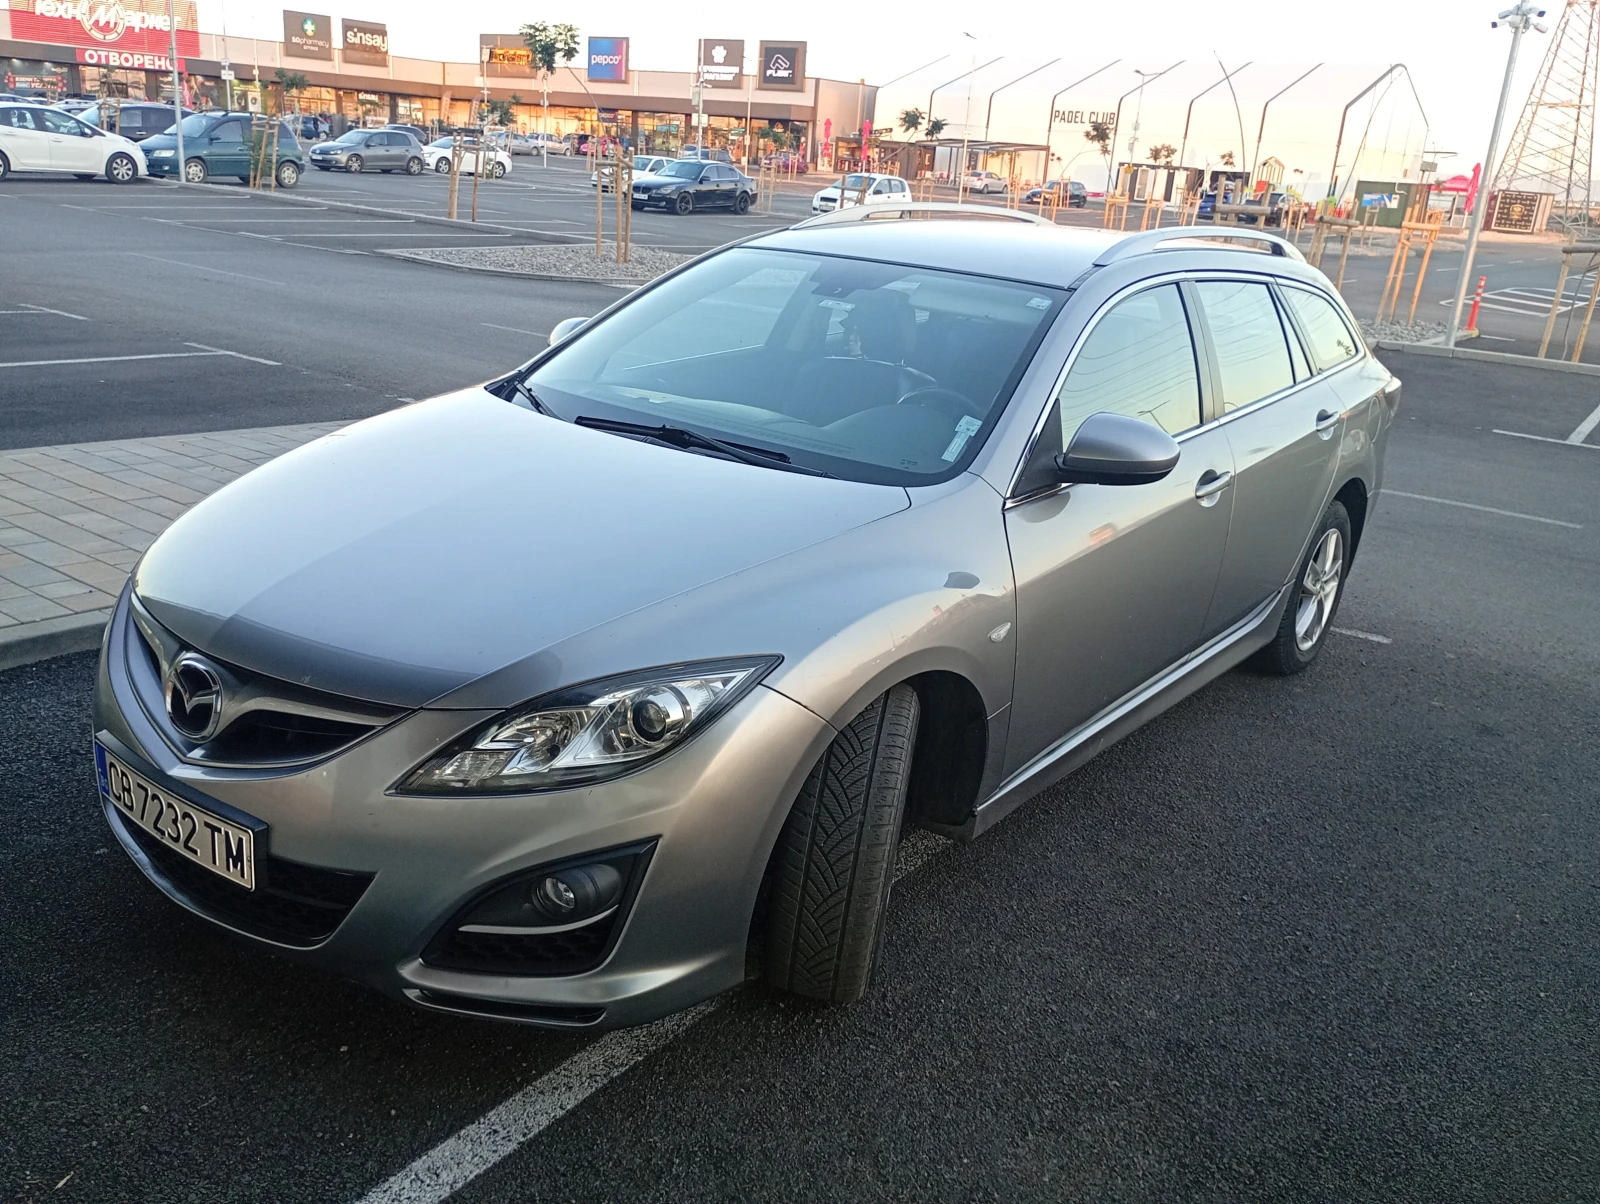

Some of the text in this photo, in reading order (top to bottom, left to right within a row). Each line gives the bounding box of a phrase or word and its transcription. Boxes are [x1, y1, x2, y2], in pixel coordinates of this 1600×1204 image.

[291, 36, 330, 49] sopharmacy
[346, 28, 387, 52] sinsay
[84, 49, 178, 71] ОТВОРЕНО
[591, 54, 621, 66] pepco
[1053, 110, 1116, 125] PADEL CLUB
[108, 761, 247, 880] CB 7232 TM
